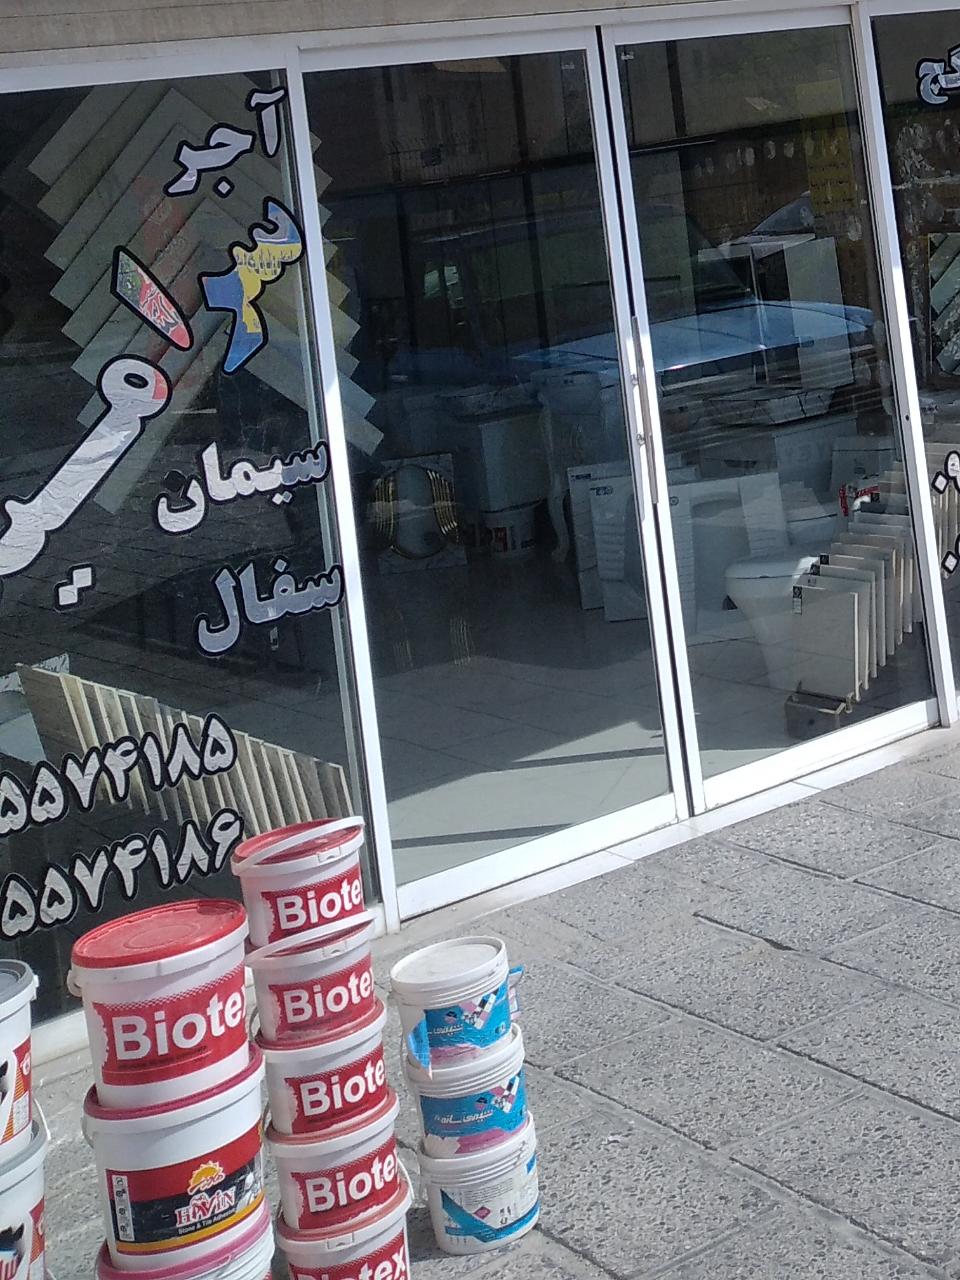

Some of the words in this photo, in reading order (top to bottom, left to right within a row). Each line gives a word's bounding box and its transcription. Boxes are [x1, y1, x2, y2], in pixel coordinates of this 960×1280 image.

[163, 86, 286, 198] آجر
[0, 197, 306, 608] سرامی
[155, 439, 331, 536] سیمان
[195, 554, 346, 660] سفال
[276, 878, 363, 930] Biote
[111, 984, 246, 1061] Biote
[283, 967, 375, 1024] Biote
[300, 1058, 386, 1117] Biote
[304, 1148, 400, 1213] Biote
